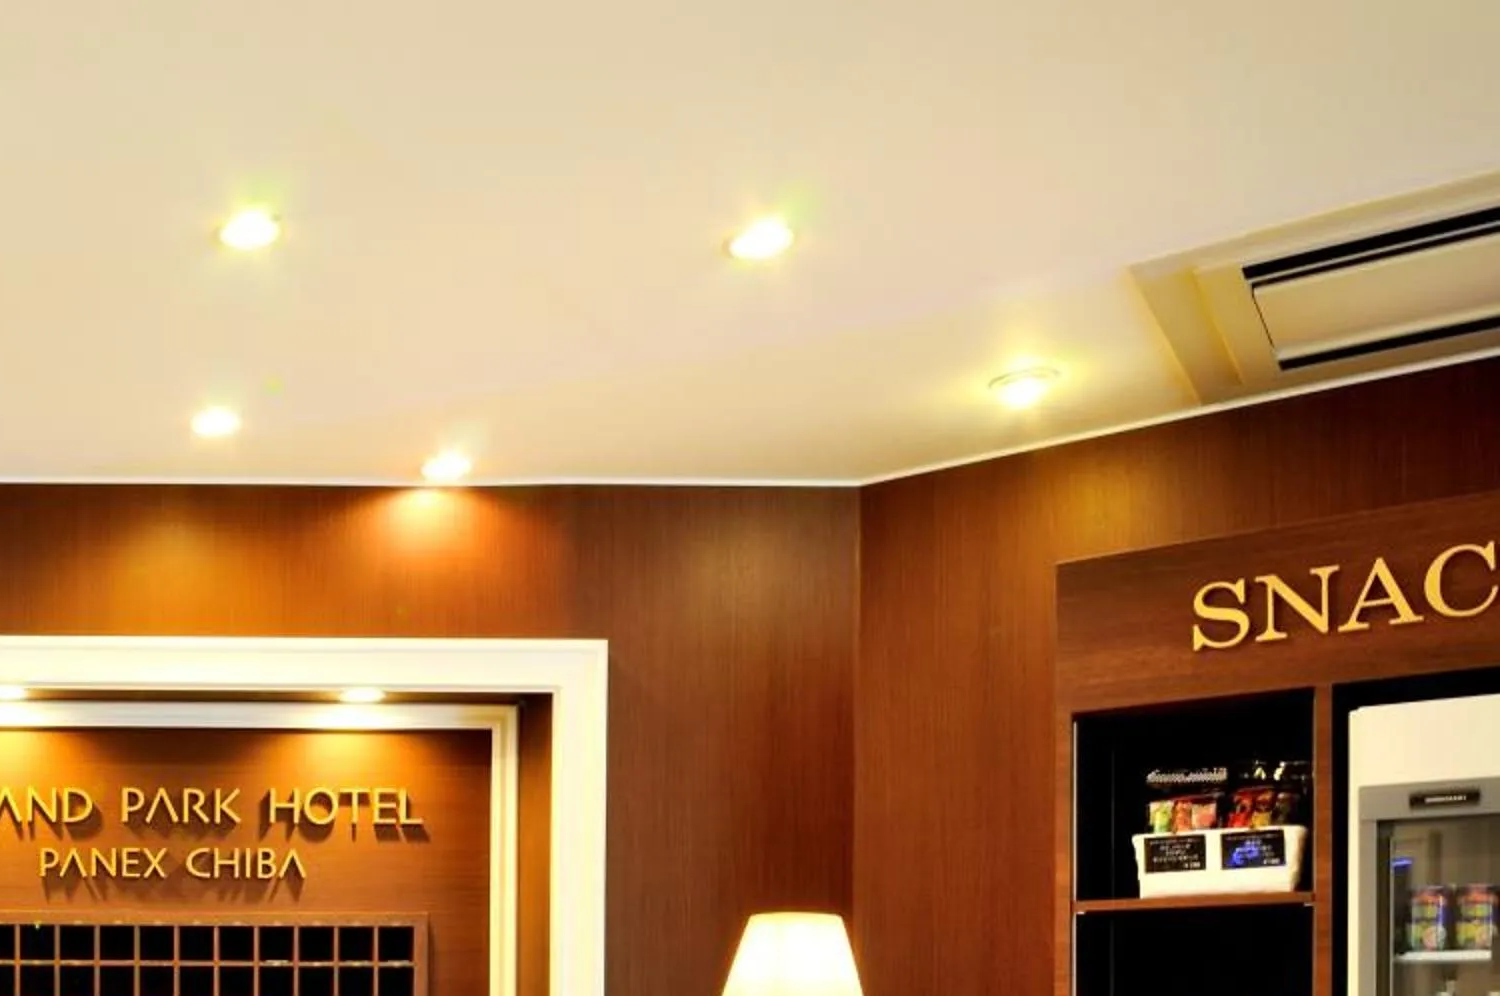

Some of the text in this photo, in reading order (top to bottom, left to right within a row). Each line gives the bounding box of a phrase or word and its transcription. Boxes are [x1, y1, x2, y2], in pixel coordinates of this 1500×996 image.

[1192, 540, 1499, 652] SNAC
[120, 786, 242, 825] PARK
[268, 786, 424, 826] HOTEL
[38, 847, 307, 880] PANEX CHIBA
